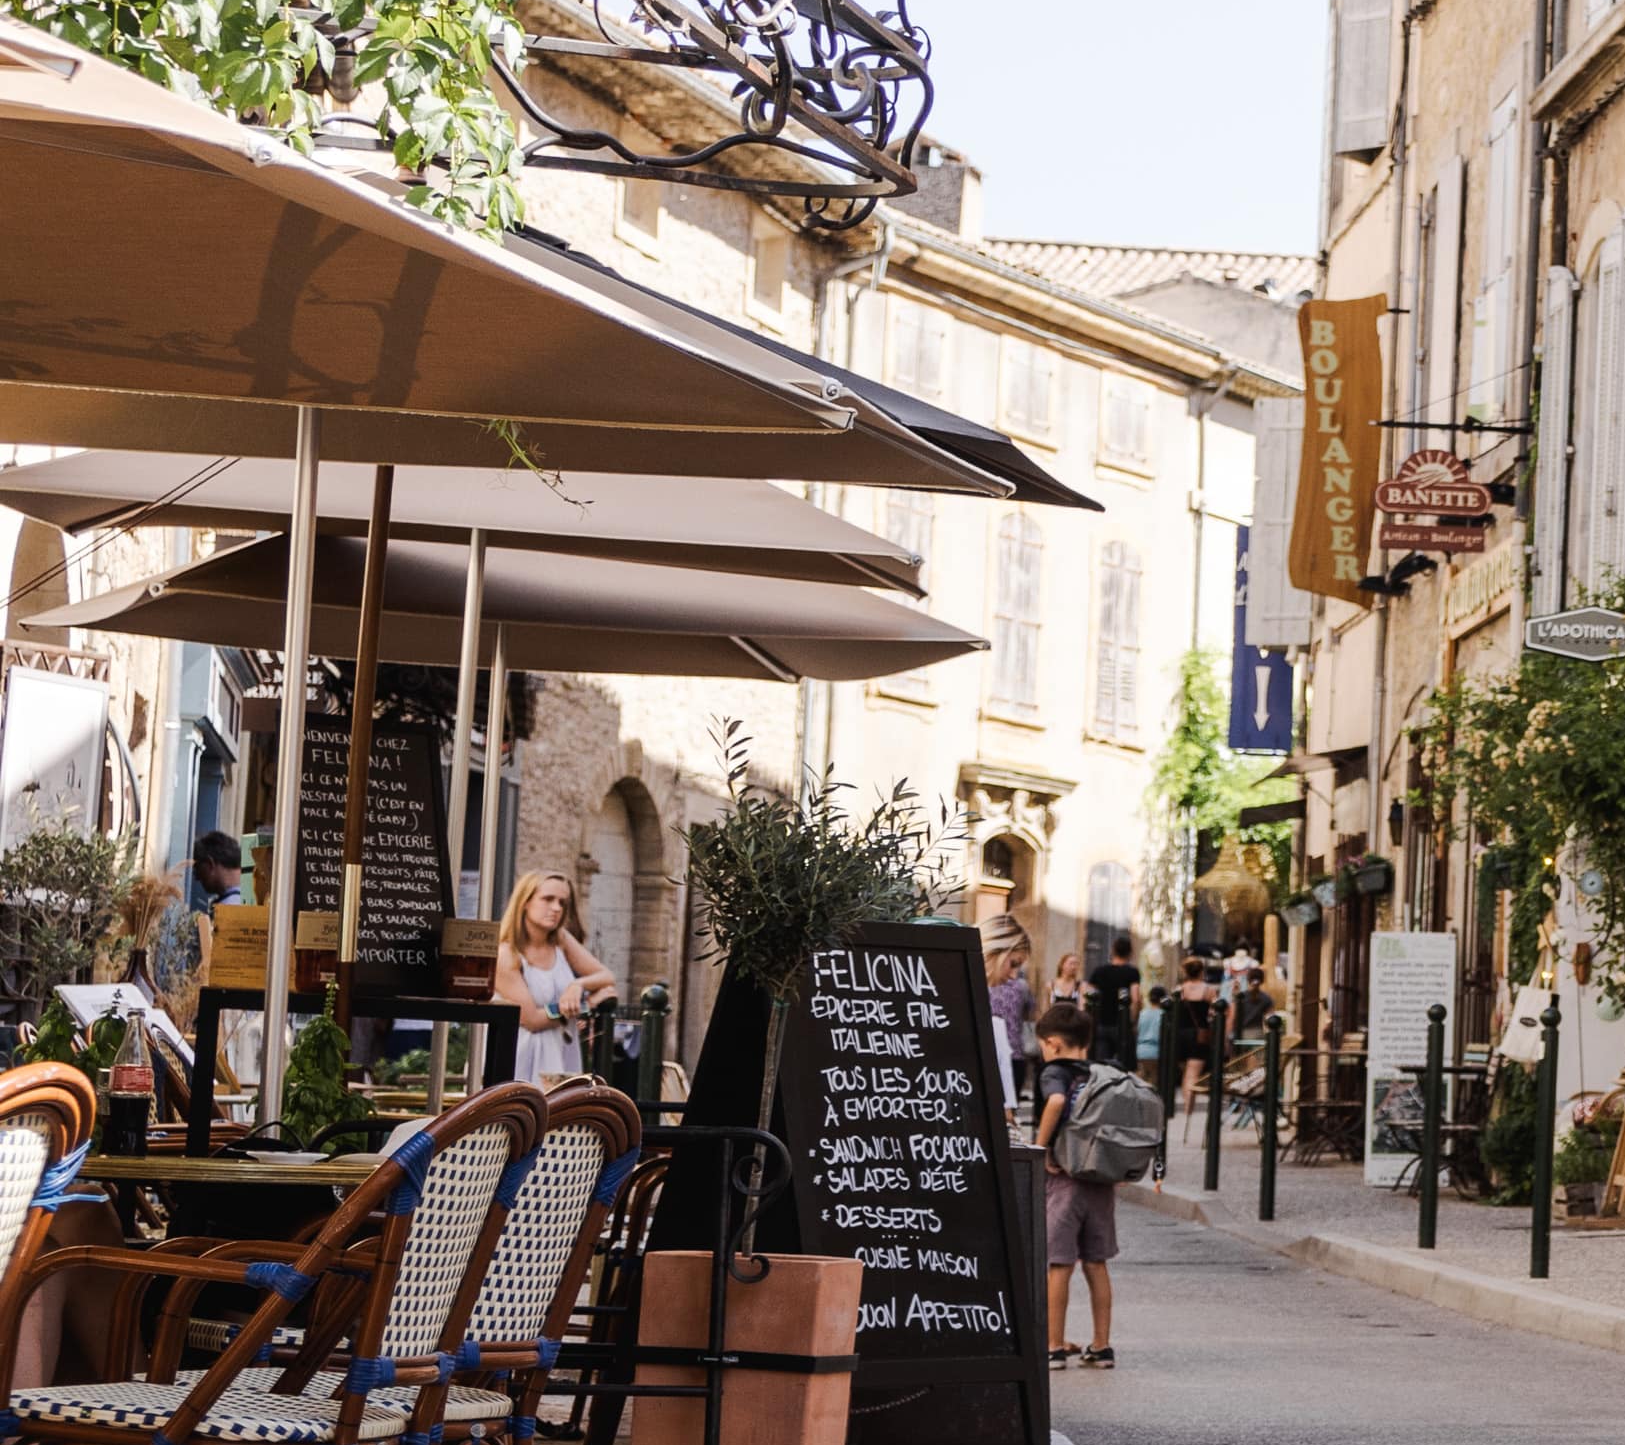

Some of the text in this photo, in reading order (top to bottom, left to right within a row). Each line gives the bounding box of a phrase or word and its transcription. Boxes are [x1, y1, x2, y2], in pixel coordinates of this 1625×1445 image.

[1309, 320, 1363, 582] BOULANGER
[1387, 487, 1479, 508] BANETTE
[376, 737, 411, 751] CHEZ
[323, 830, 345, 843] C'ES
[355, 947, 427, 966] MPORTER
[813, 949, 939, 997] FELICINA
[811, 990, 950, 1029] ÉPICERIE FINE
[830, 1027, 925, 1060] ITALIENNE
[820, 1065, 973, 1099] TOUS LES JOURS
[823, 1095, 841, 1127] À
[819, 1133, 987, 1165] SANDWICH FOCACCIA
[827, 1166, 910, 1194] SALADES
[835, 1203, 943, 1233] DESSERTS
[854, 1244, 979, 1280] CUISINE MAISON
